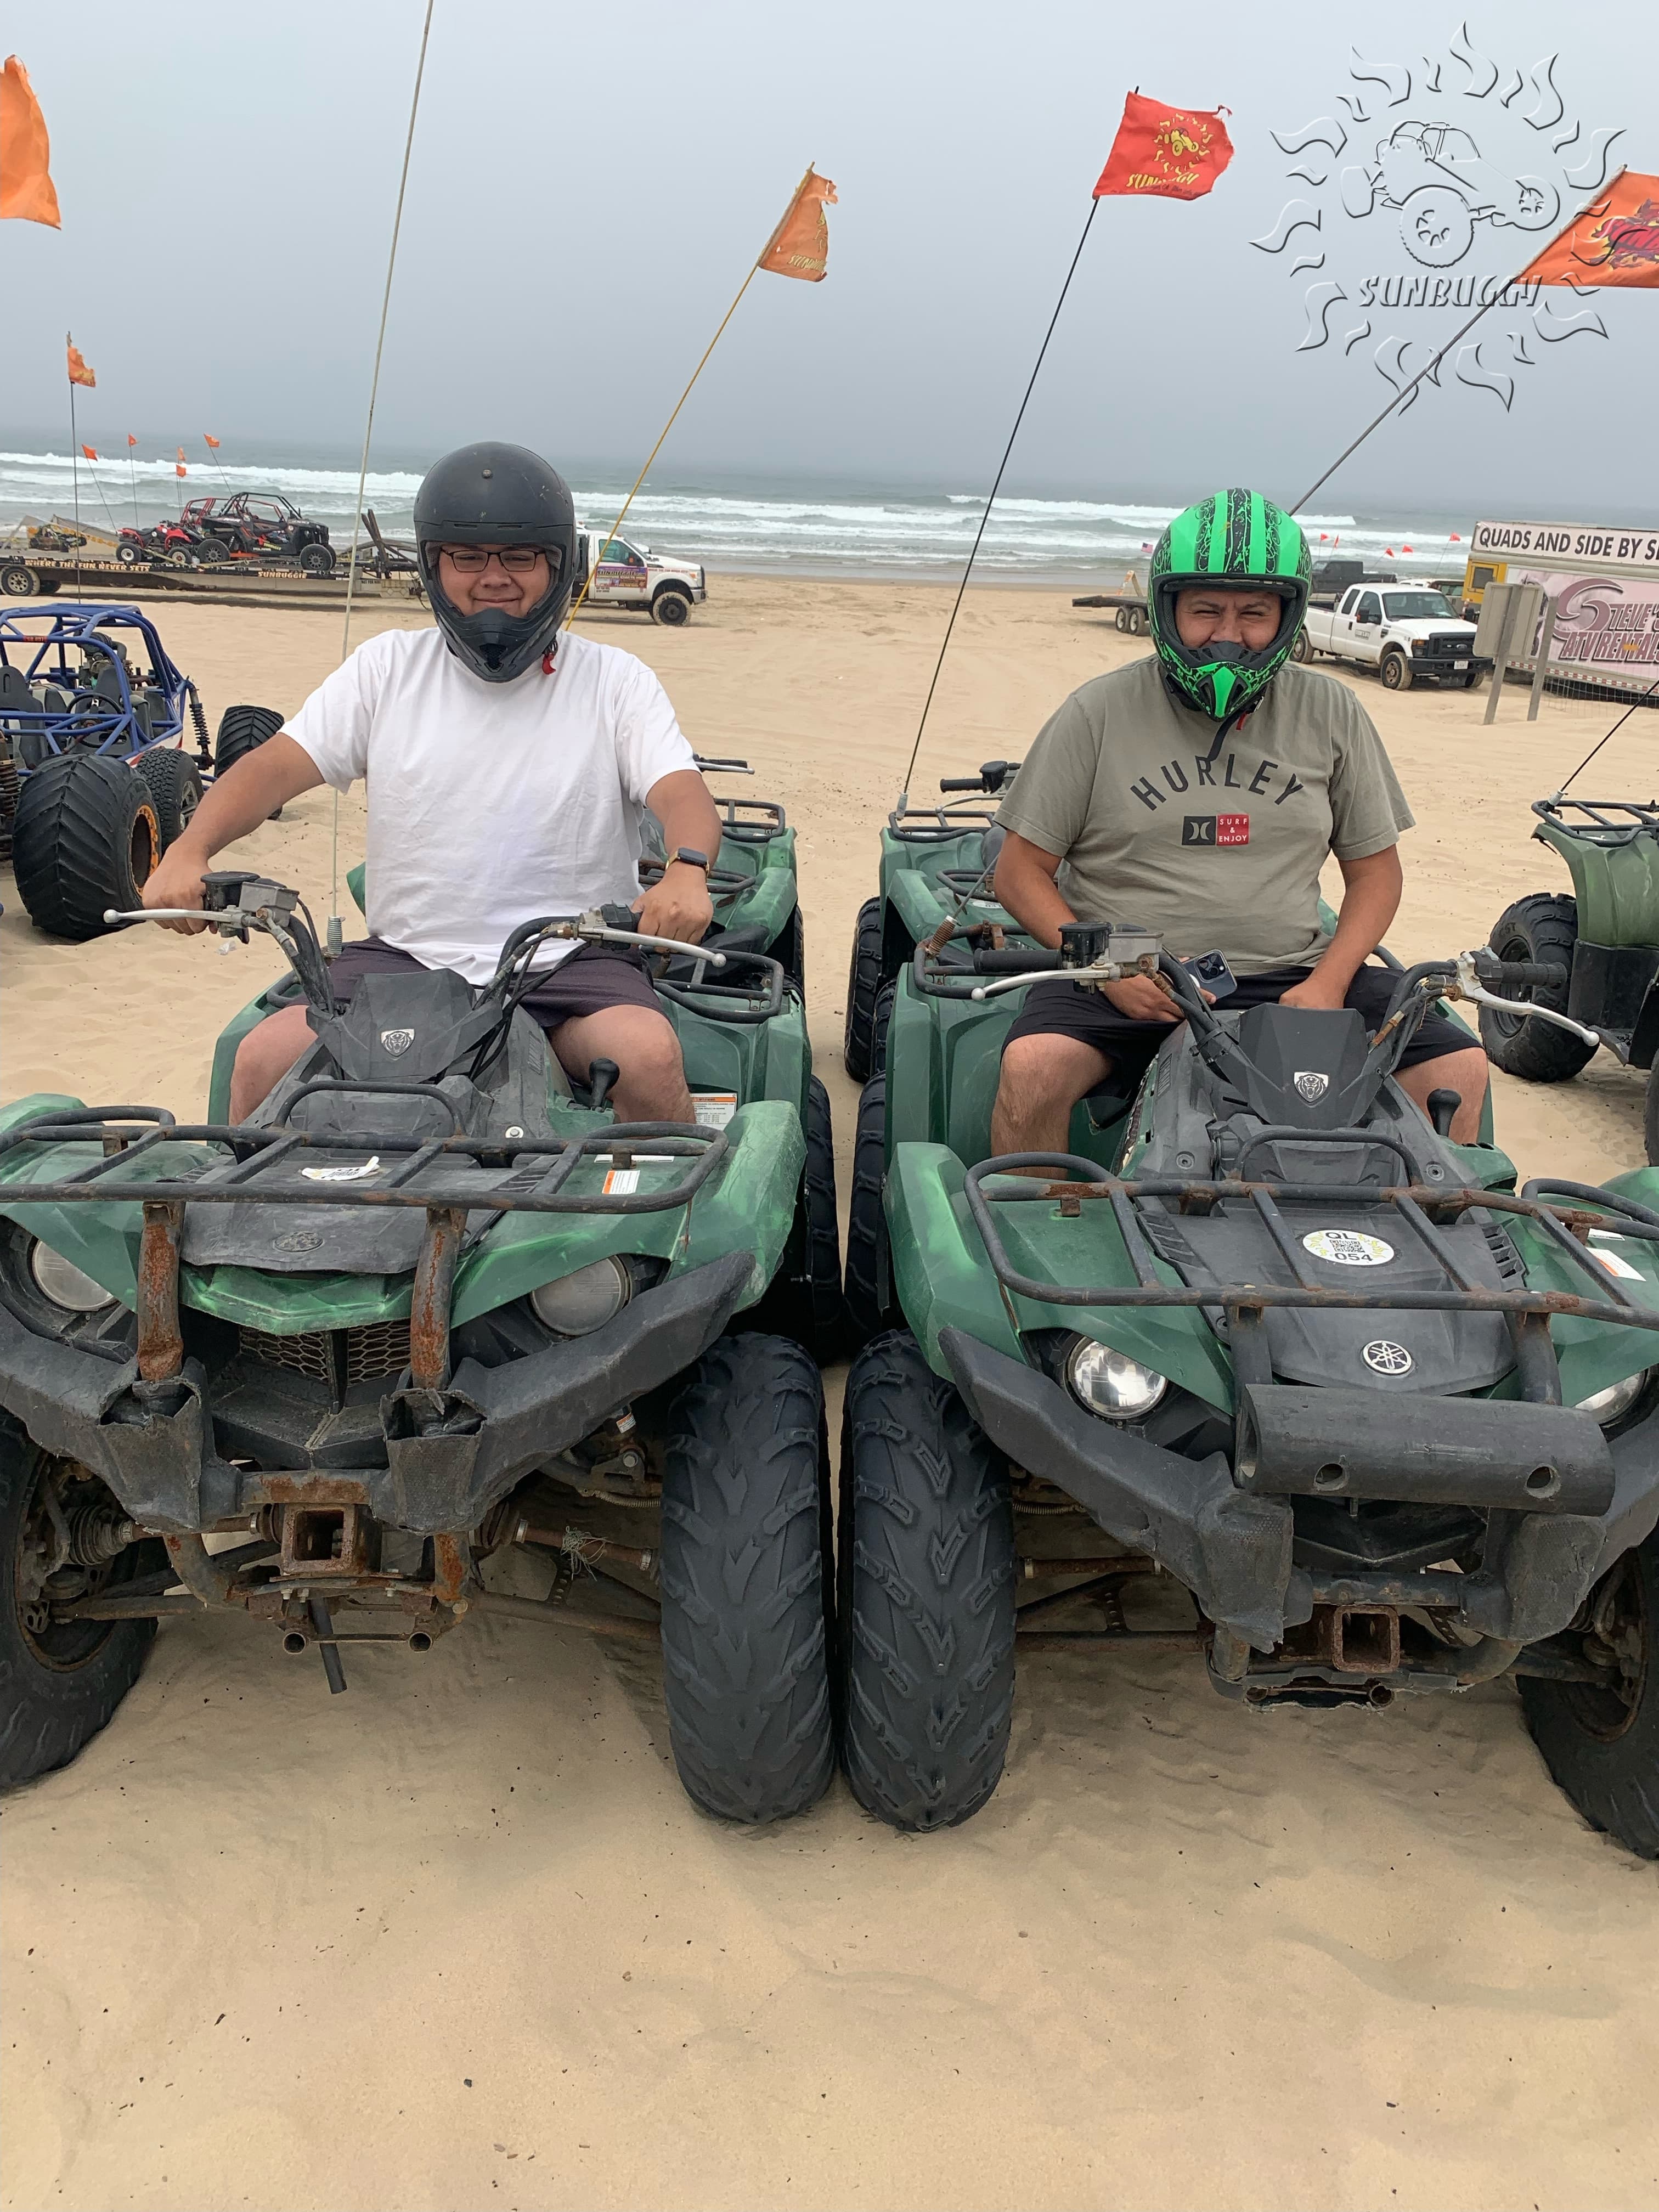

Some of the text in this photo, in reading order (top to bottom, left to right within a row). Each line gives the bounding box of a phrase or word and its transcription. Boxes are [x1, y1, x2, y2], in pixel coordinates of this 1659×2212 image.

[1479, 527, 1532, 549] QUADS
[1533, 532, 1571, 552] AND
[1574, 534, 1614, 557] SIDE
[1617, 538, 1643, 558] BY
[258, 571, 308, 579] SUNBUGGIE
[1560, 631, 1659, 663] ATV RENTAL
[1130, 754, 1304, 811] HURLEY
[1325, 1232, 1357, 1240] QL
[1334, 1252, 1373, 1261] 054
